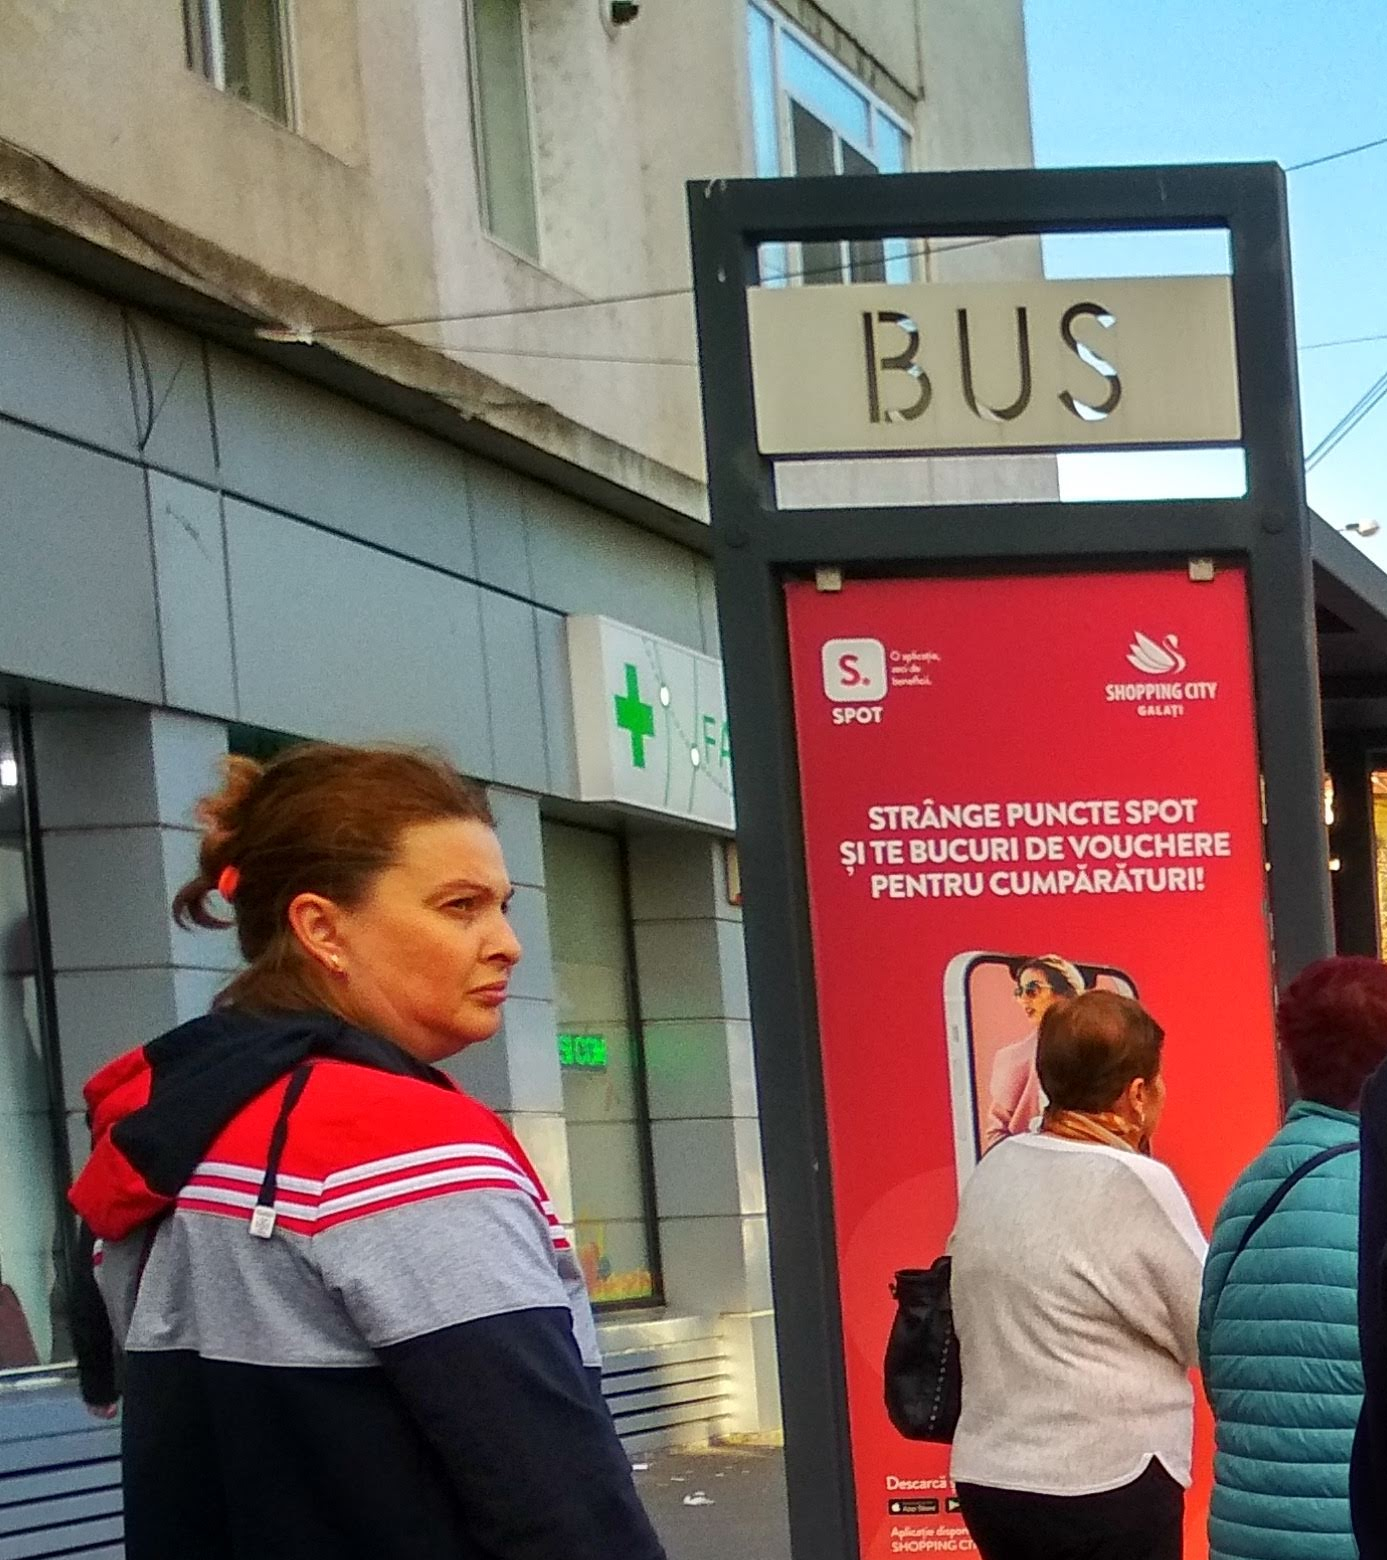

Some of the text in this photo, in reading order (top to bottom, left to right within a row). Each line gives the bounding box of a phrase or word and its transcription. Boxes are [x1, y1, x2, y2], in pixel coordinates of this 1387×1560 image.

[862, 302, 1123, 424] BUS
[1105, 681, 1218, 702] SHOPPING CITY
[832, 706, 883, 725] SPOT
[867, 798, 1198, 831] STRÂNGE PUNCTE SPOT
[839, 831, 1231, 876] ȘI TE BUCURI DE VOUCHERE
[870, 861, 1205, 899] PENTRU CUMPĂRĂTURI!
[885, 1475, 947, 1491] Descarcă
[891, 1539, 957, 1553] SHOPPING
